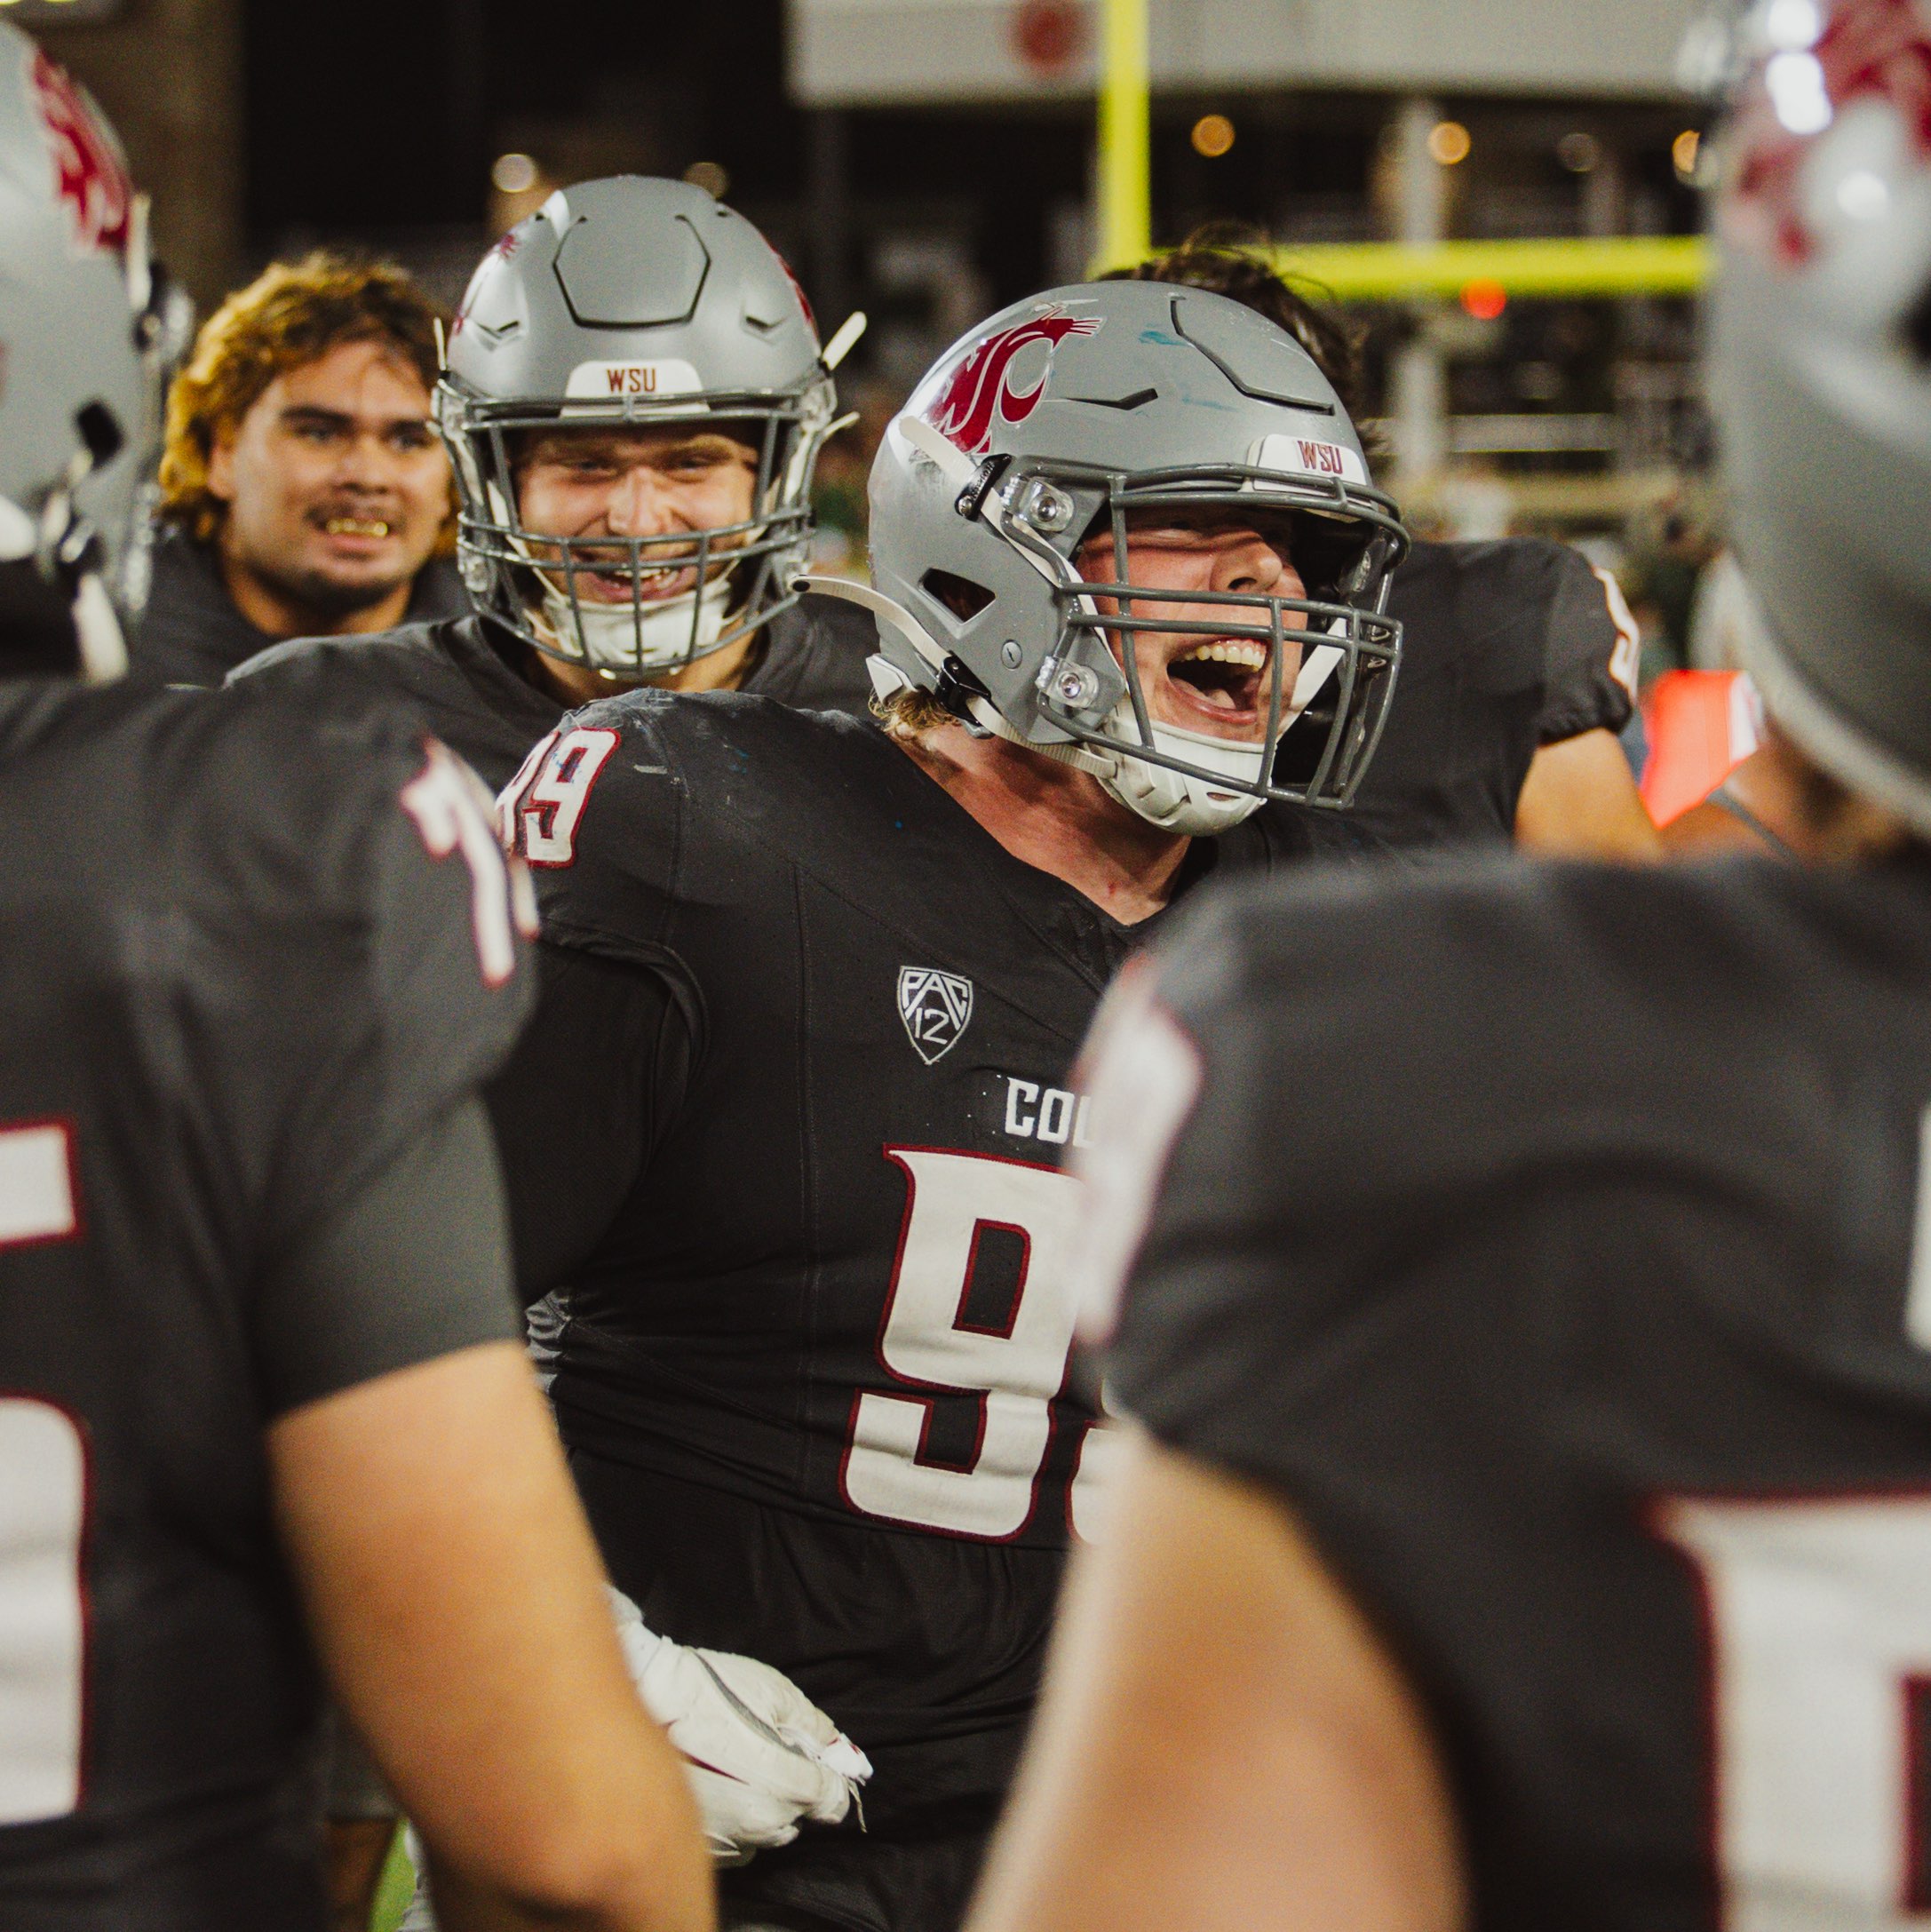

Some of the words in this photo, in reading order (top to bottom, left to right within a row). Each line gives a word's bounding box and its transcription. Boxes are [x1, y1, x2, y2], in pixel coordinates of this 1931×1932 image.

[606, 367, 656, 394] WSU
[1297, 440, 1344, 475] WSU
[901, 970, 969, 1031] PAC
[914, 1006, 950, 1045] 12
